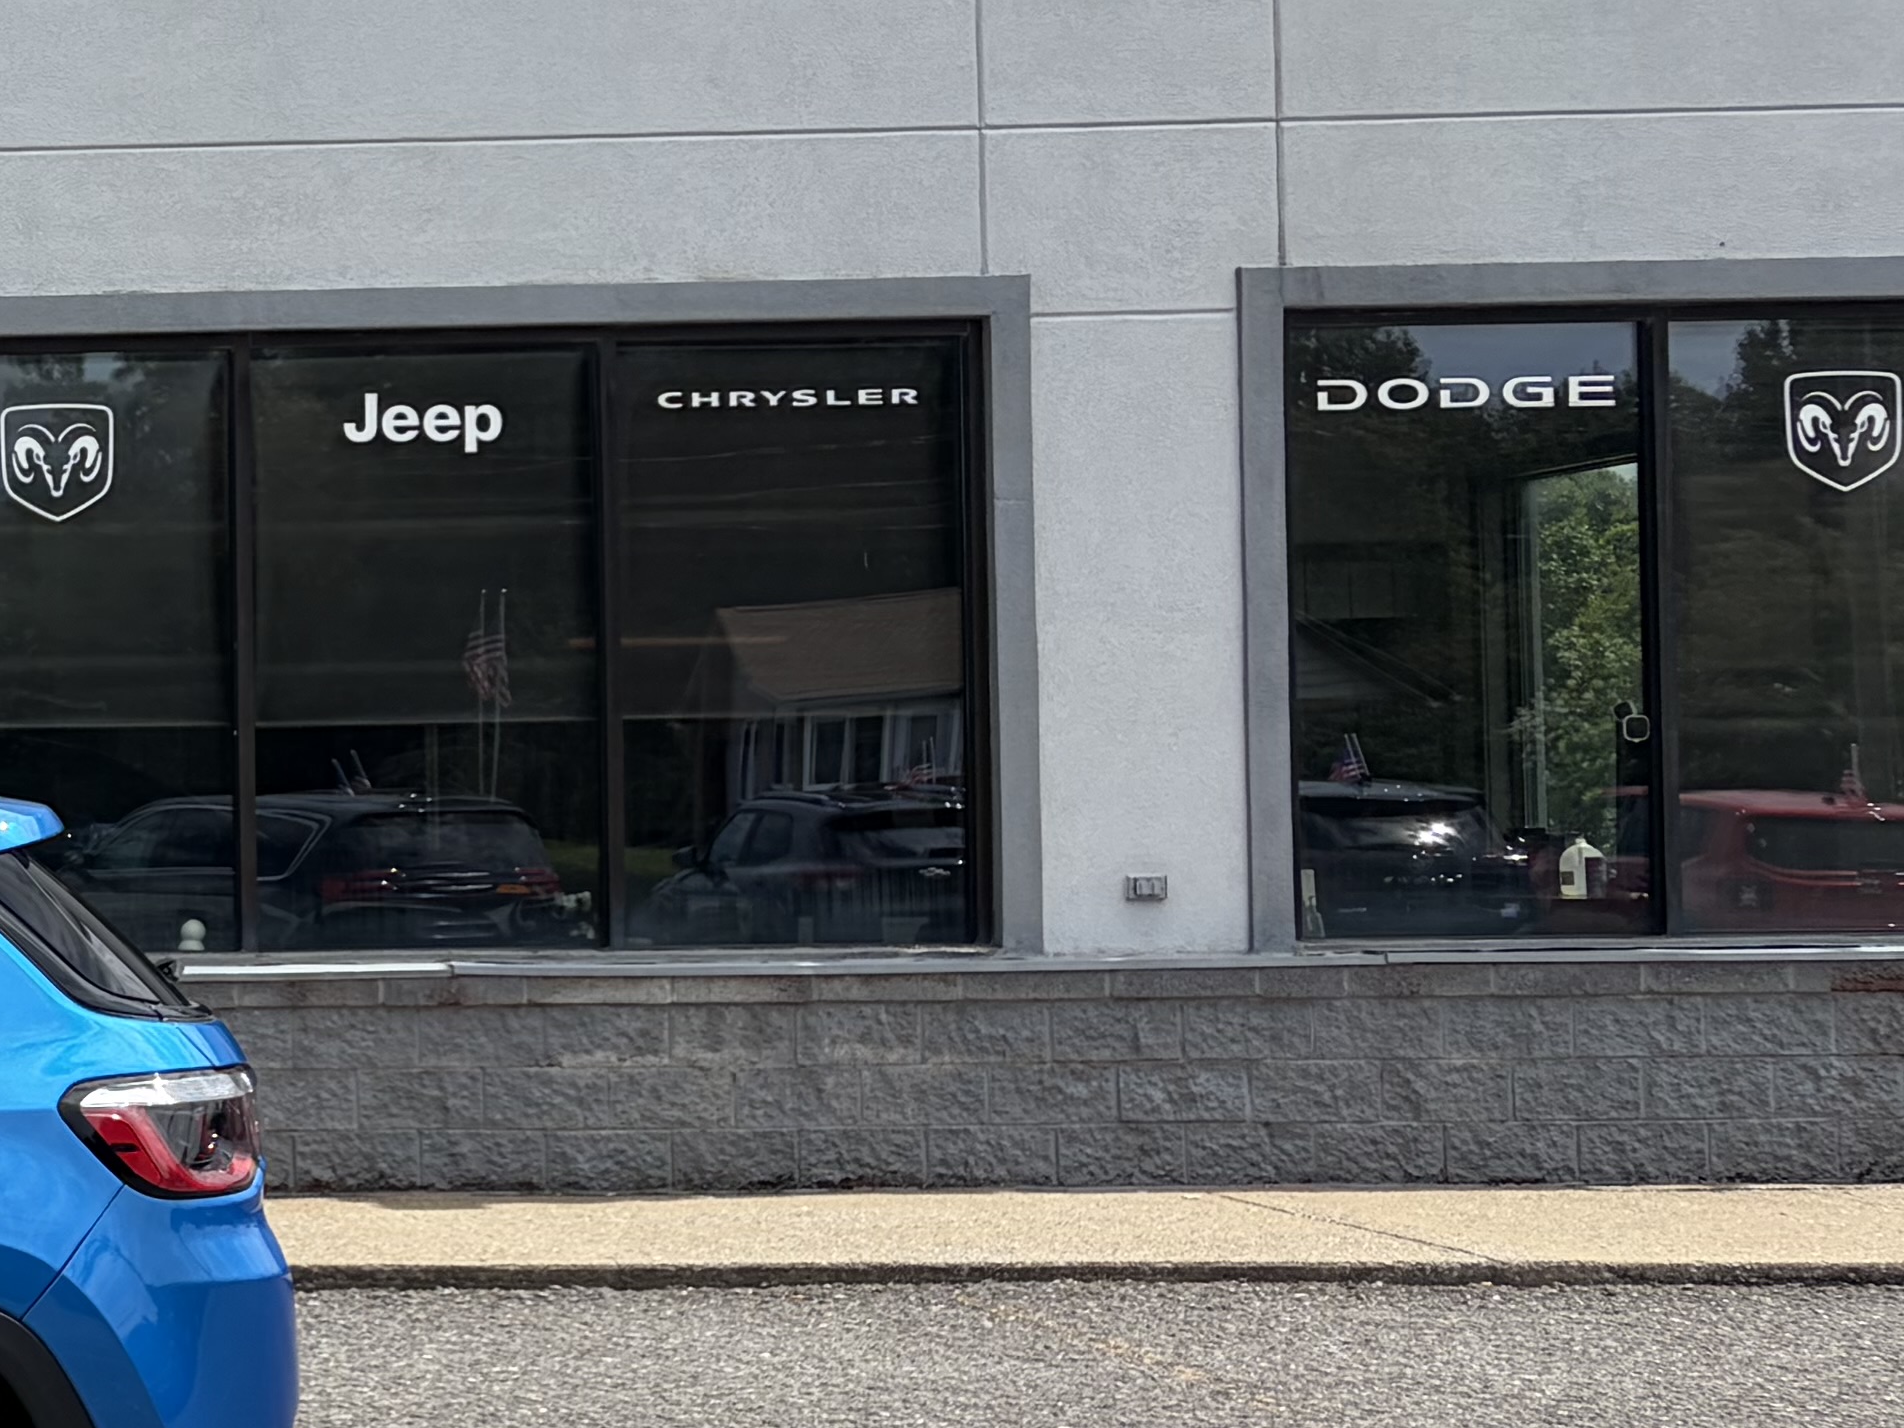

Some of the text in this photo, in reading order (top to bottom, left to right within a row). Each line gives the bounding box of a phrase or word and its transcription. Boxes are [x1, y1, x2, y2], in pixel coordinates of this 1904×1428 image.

[656, 387, 919, 410] CHRYSLER
[1316, 375, 1616, 411] DODGE
[343, 393, 504, 453] Jeep
